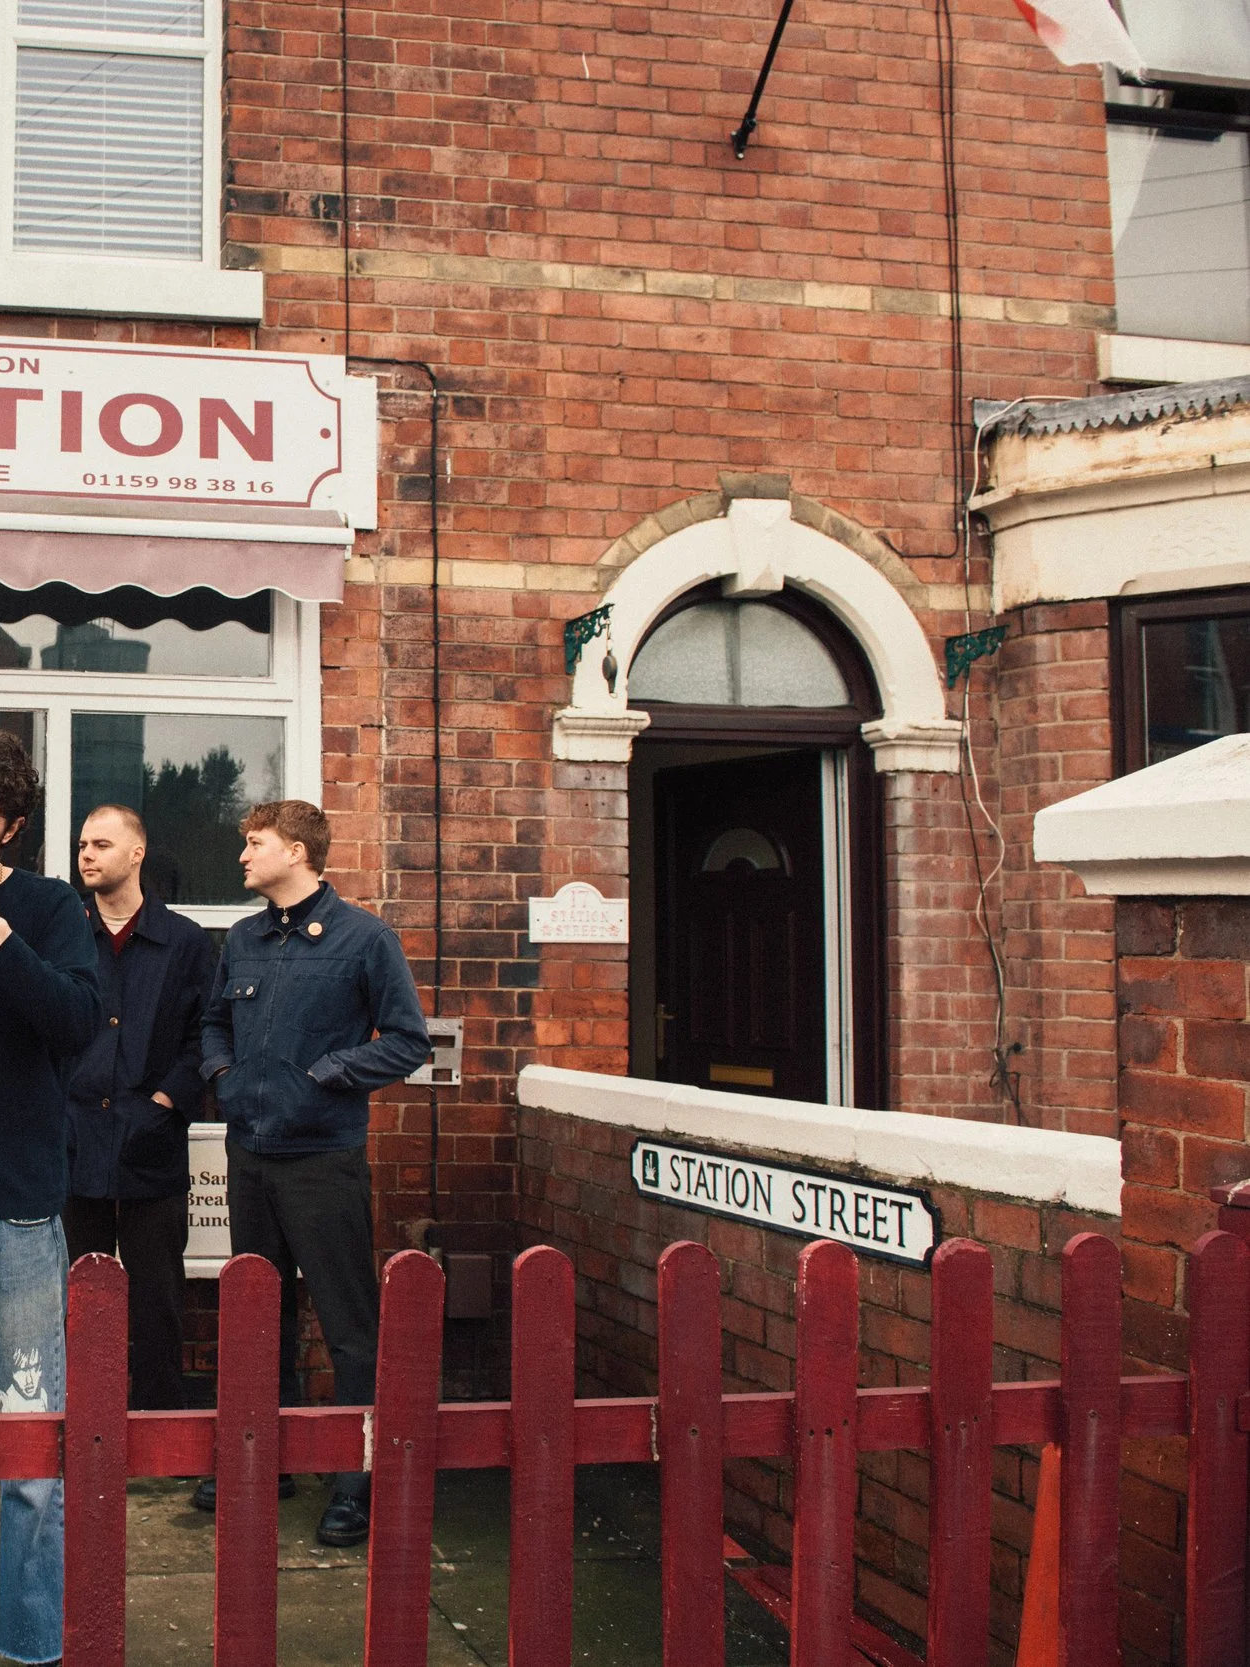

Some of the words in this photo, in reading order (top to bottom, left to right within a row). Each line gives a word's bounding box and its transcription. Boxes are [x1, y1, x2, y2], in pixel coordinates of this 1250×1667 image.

[82, 473, 159, 488] 01159
[168, 477, 198, 490] 98
[207, 478, 236, 492] 38
[246, 480, 274, 493] 16
[550, 909, 610, 922] STATION
[555, 924, 606, 937] STREET
[669, 1154, 773, 1216] STATION
[792, 1179, 913, 1248] STREET
